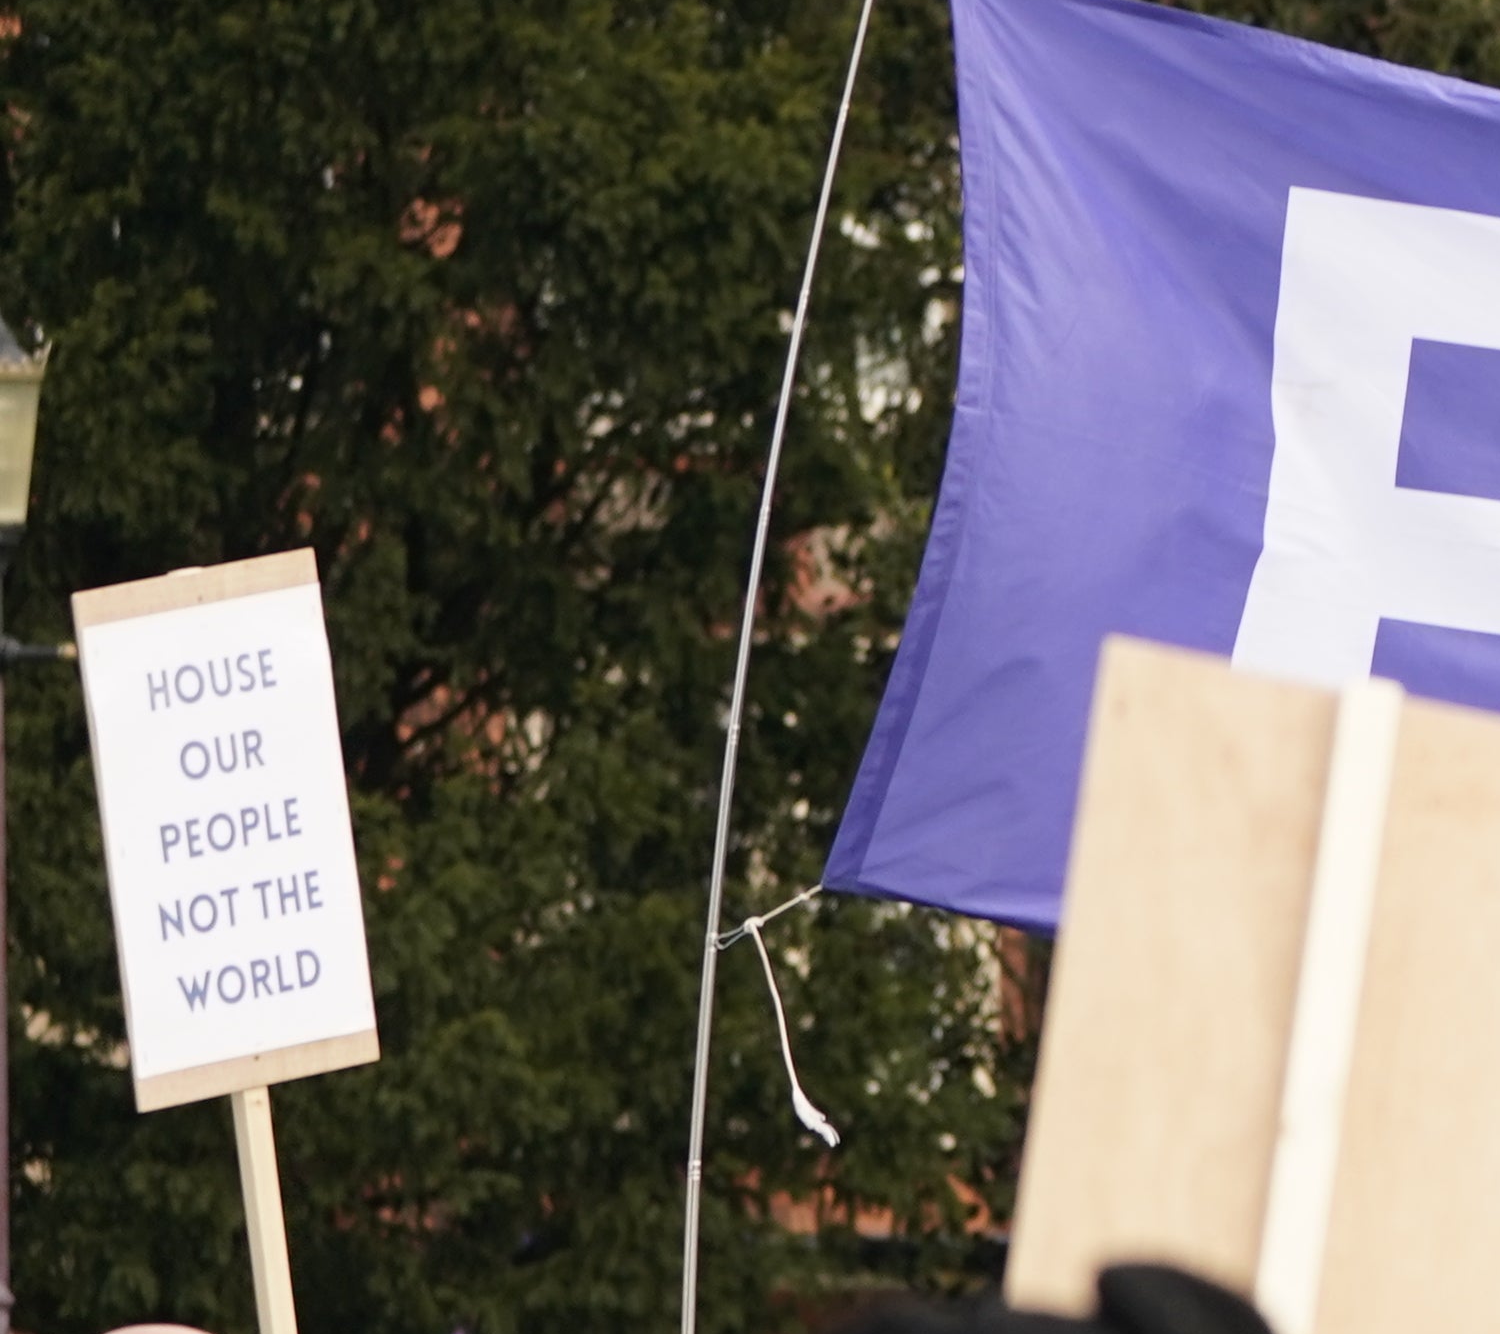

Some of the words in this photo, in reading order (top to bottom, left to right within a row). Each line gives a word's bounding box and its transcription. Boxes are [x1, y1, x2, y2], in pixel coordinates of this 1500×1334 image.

[147, 649, 277, 711] HOUSE
[180, 729, 265, 780] OUR
[160, 797, 302, 863] PEOPLE
[158, 887, 240, 942] NOT
[253, 870, 324, 919] THE
[177, 949, 321, 1013] WORLD
